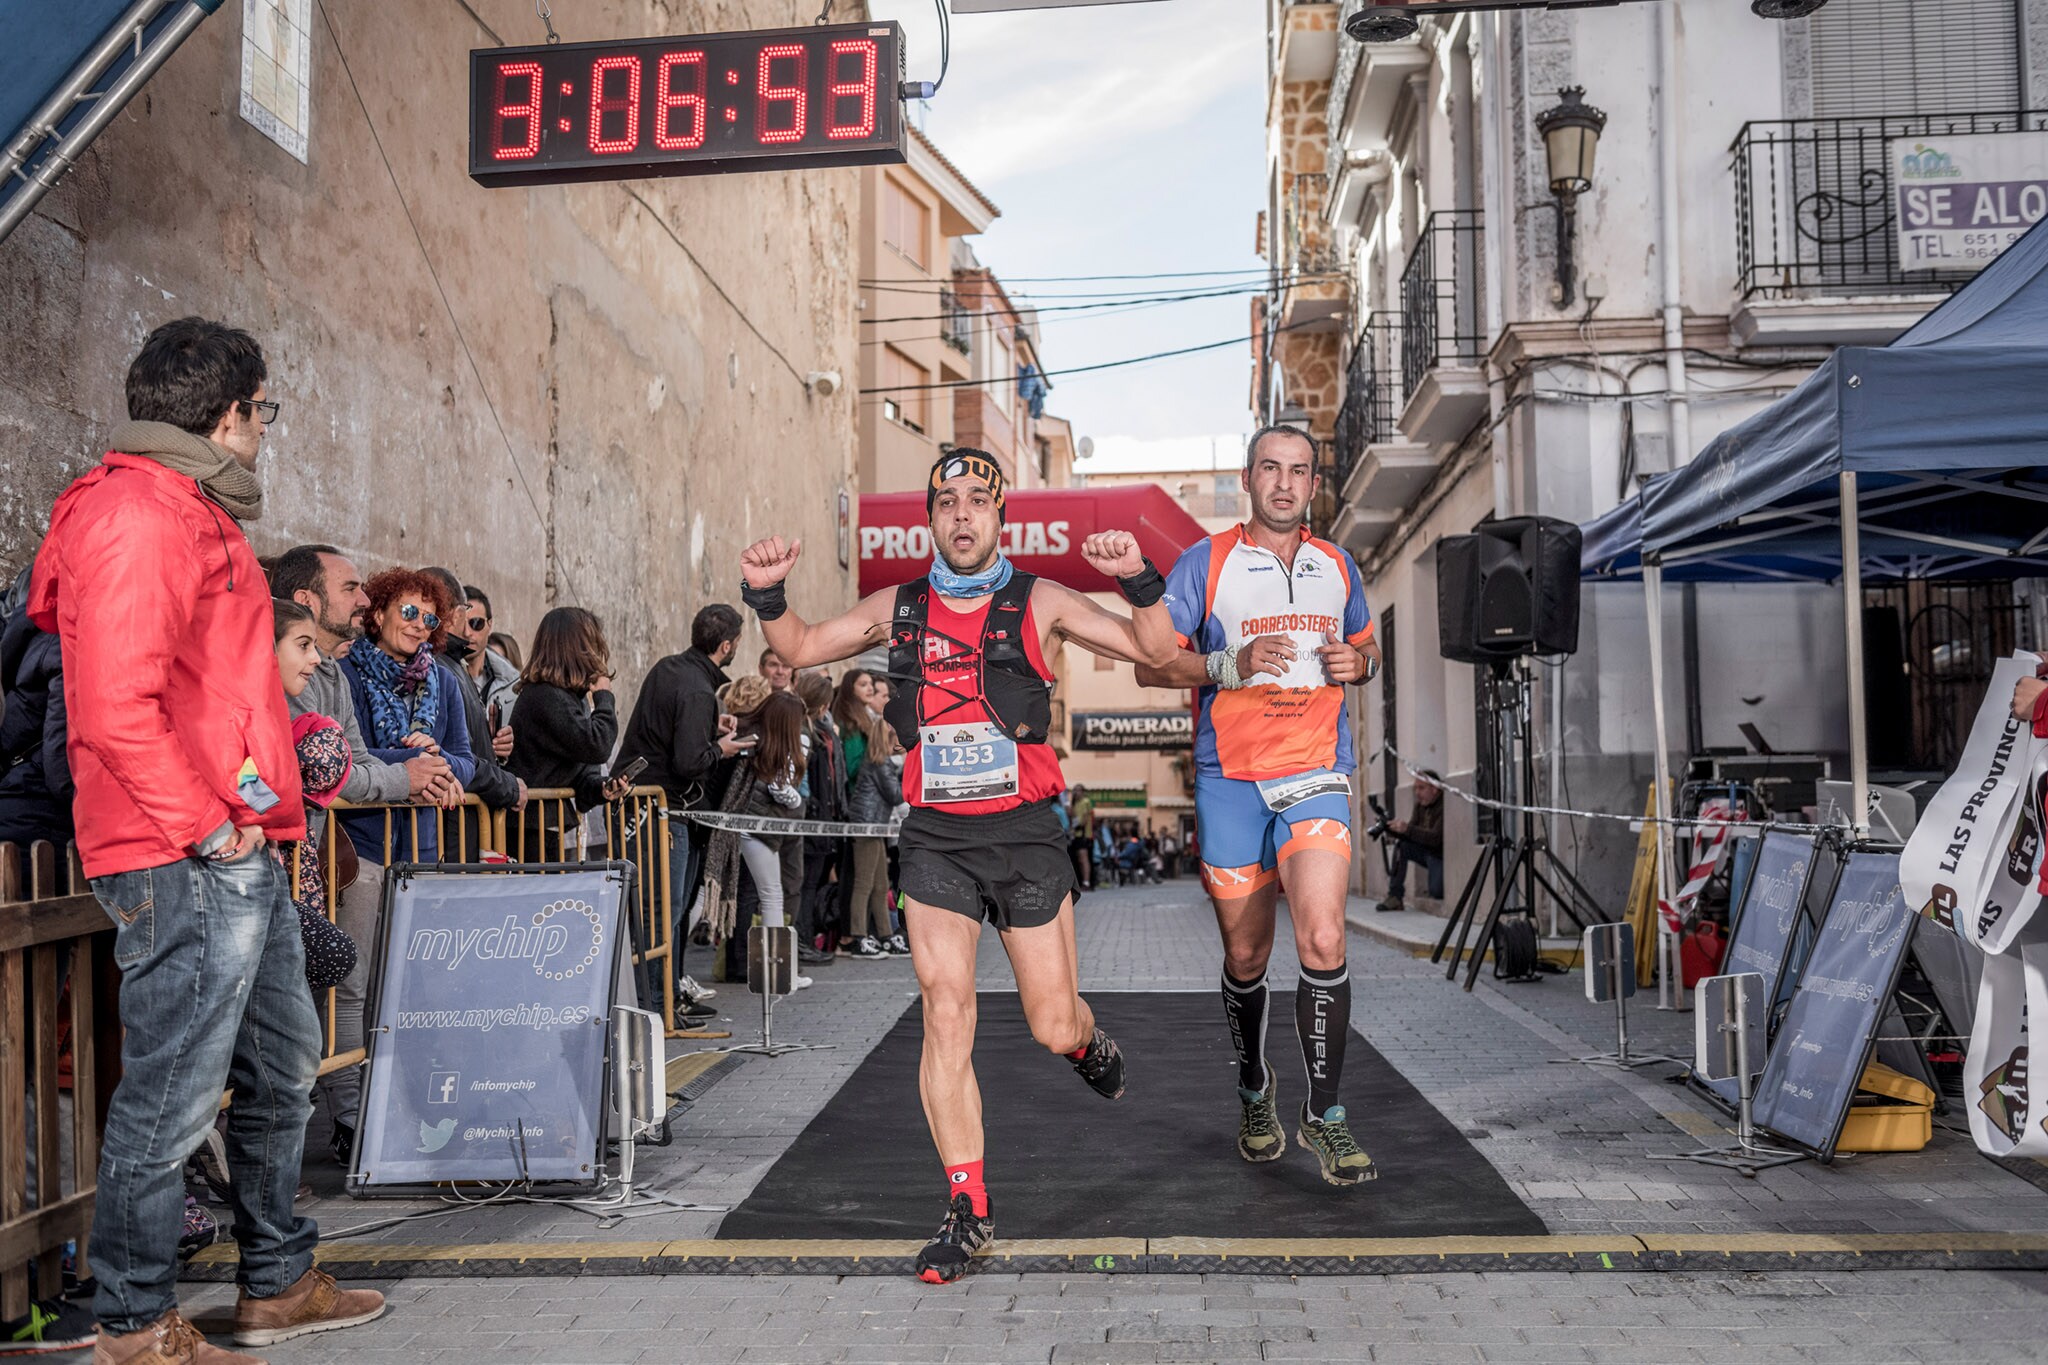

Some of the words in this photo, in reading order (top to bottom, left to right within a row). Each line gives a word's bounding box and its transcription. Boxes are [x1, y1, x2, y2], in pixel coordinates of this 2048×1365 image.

[495, 40, 878, 159] 3:06:53
[1907, 188, 1953, 226] SE
[1971, 185, 2048, 225] ALQ
[1964, 233, 1997, 245] 651
[1965, 248, 1999, 259] 964
[860, 521, 1070, 560] PROCIAS
[1241, 613, 1339, 637] CORRECOSTERES
[939, 744, 994, 766] 1253
[1939, 826, 1971, 874] LAS
[1978, 899, 2002, 939] AS
[406, 914, 569, 970] mychip
[398, 1003, 590, 1031] www.mychip.es
[1308, 988, 1335, 1079] Kalenji
[470, 1080, 536, 1093] /infomychip
[463, 1126, 544, 1141] @Mychip_Info
